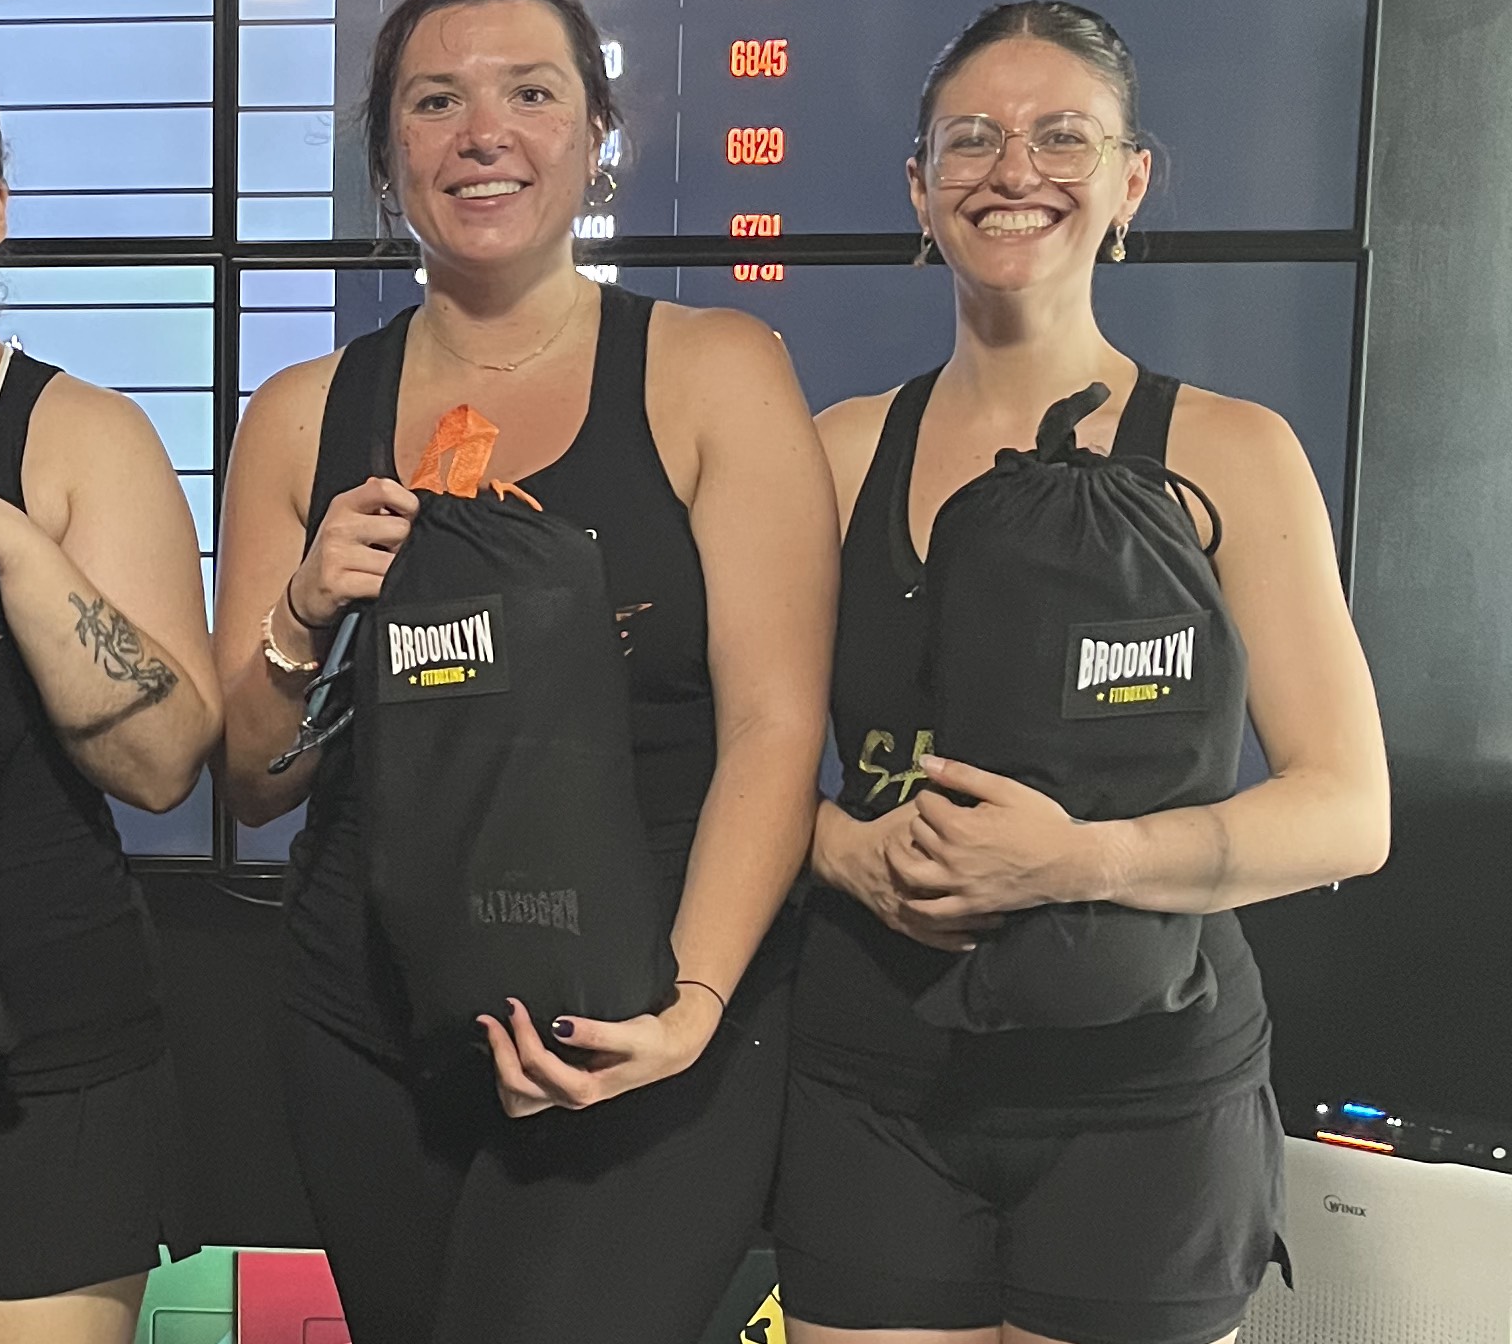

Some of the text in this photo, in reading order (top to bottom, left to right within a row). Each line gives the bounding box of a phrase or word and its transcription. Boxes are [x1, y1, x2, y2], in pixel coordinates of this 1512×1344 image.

[729, 39, 788, 77] 6845
[726, 126, 785, 165] 6829
[388, 610, 495, 676] BROOKLYN
[1077, 626, 1195, 691] BROOKLYN
[1328, 1198, 1367, 1218] WINIX
